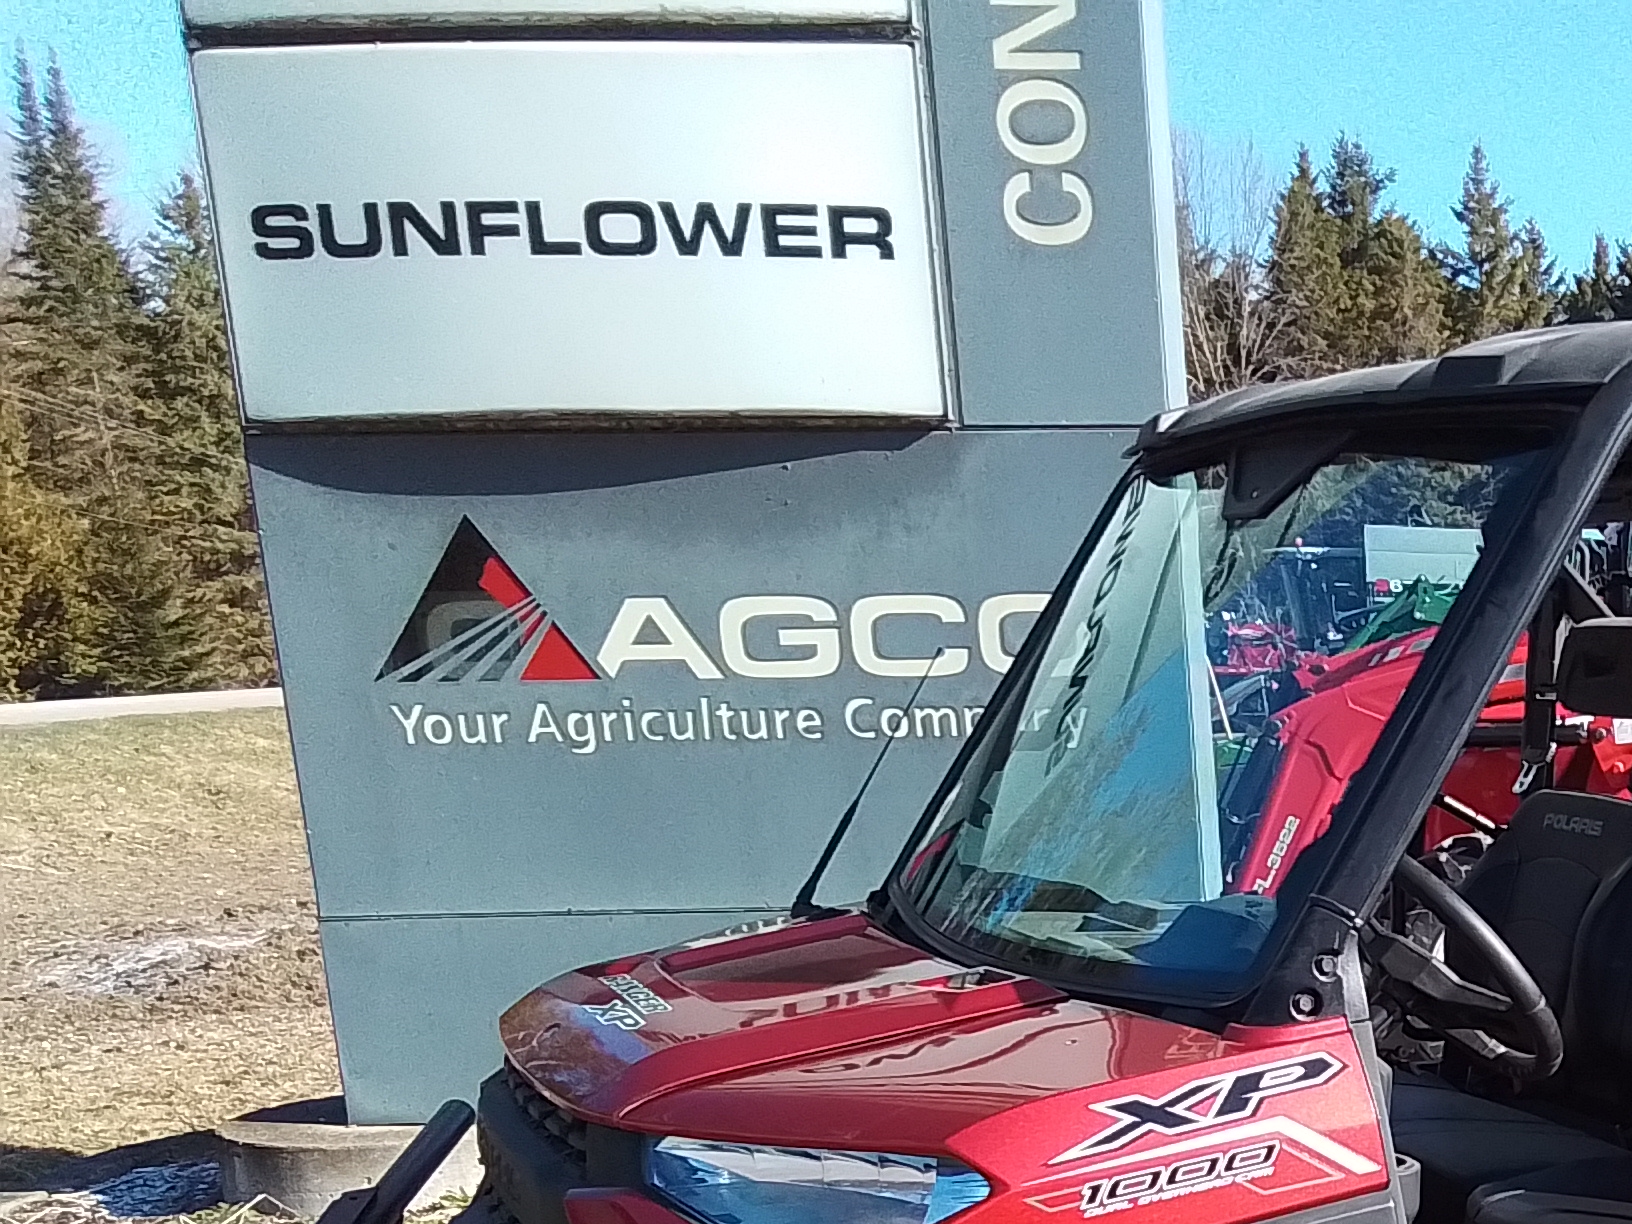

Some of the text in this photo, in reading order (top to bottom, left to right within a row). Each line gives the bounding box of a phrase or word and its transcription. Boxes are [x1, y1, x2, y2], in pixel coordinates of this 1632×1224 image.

[990, 0, 1093, 246] CON
[251, 201, 894, 262] SUNFLOWER
[389, 697, 1088, 754] Your Agriculture Comy
[1543, 813, 1604, 837] POLARIS
[578, 999, 646, 1030] XP
[1047, 1051, 1348, 1165] XP
[1080, 1140, 1281, 1210] 1000
